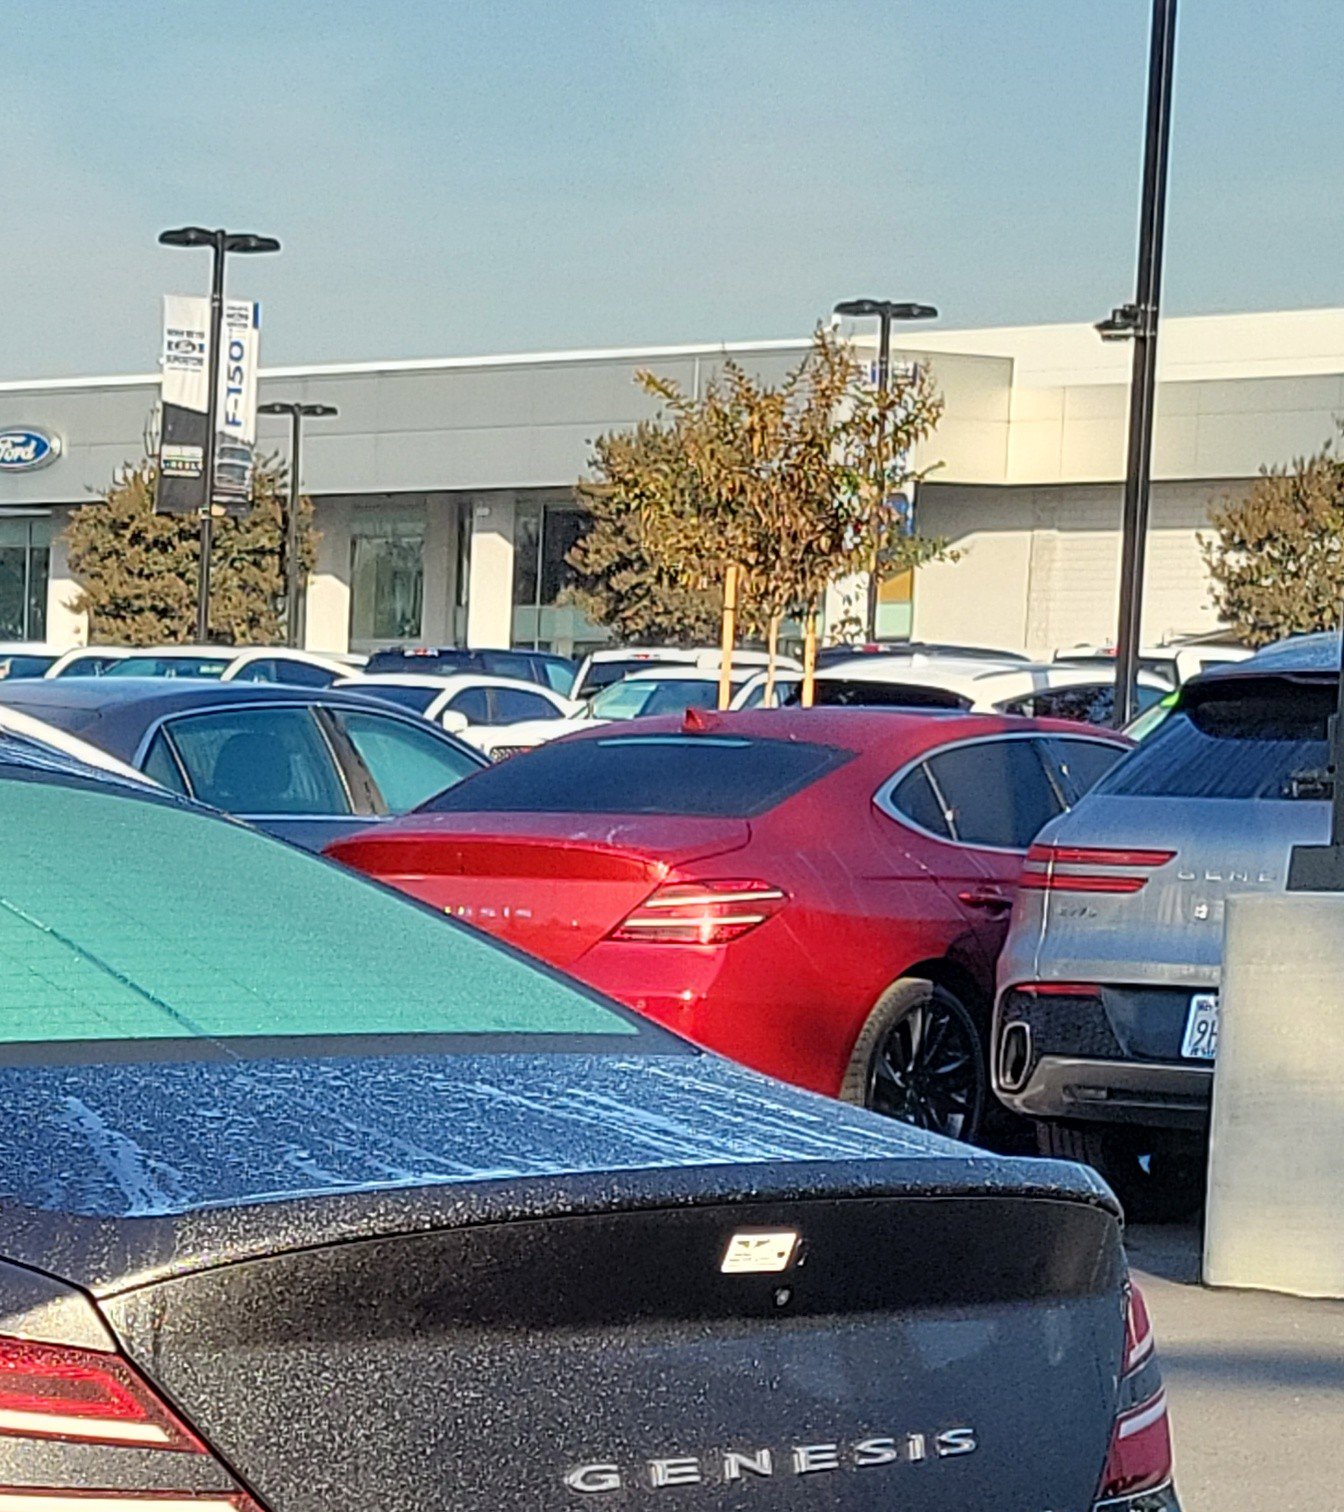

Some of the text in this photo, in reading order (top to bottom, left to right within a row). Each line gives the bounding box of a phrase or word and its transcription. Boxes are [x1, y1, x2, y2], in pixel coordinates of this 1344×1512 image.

[226, 341, 244, 427] F-150
[1177, 869, 1277, 882] GENE
[563, 1427, 978, 1493] GENESIS
